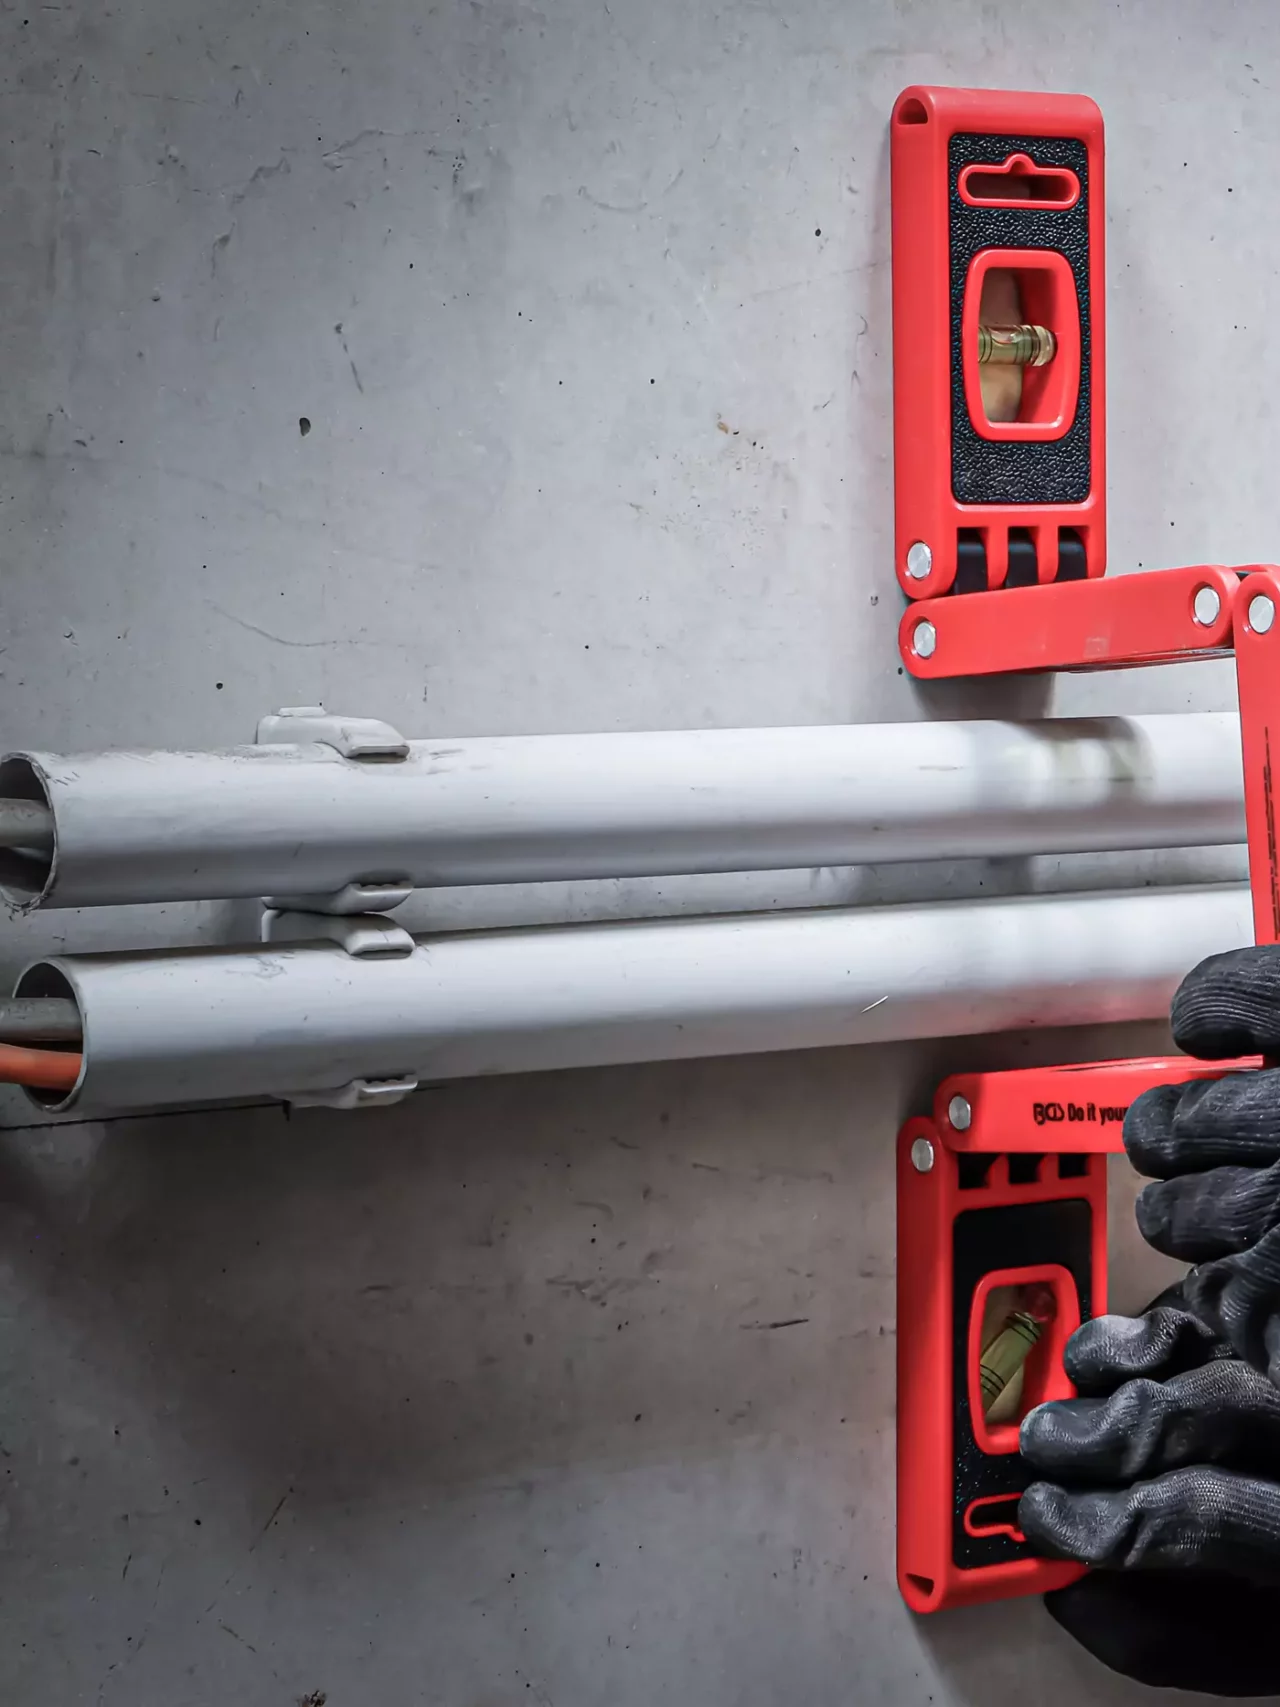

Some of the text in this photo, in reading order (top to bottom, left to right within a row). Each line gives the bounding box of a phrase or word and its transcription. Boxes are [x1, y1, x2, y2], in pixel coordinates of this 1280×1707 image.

[1067, 1103, 1085, 1122] Do
[1086, 1102, 1097, 1122] it
[1099, 1106, 1130, 1126] your
